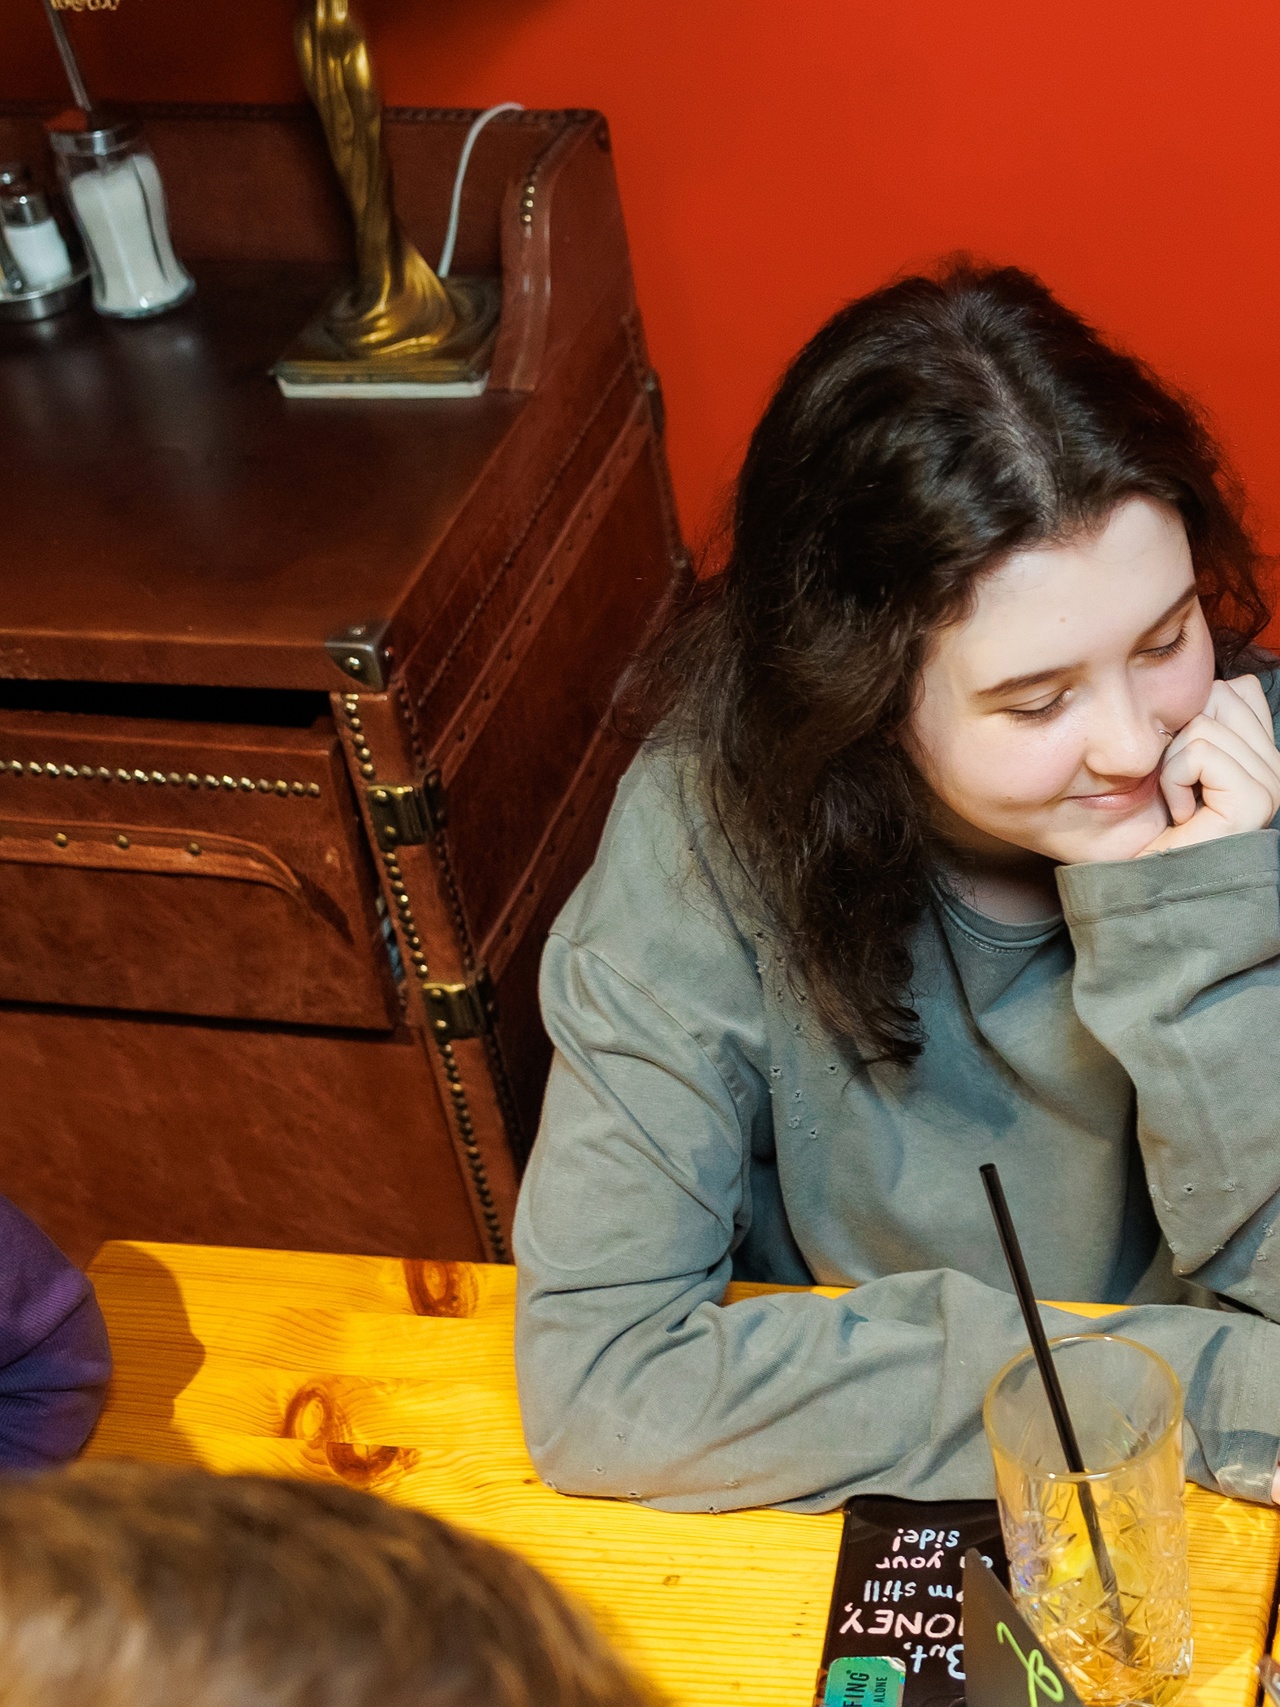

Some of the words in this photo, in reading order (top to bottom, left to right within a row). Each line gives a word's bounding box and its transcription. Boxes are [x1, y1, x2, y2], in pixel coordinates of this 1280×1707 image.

[892, 1527, 960, 1552] side!
[875, 1550, 944, 1569] your
[863, 1580, 916, 1603] still
[839, 1602, 964, 1638] ONEY,
[873, 1676, 888, 1704] ALONE
